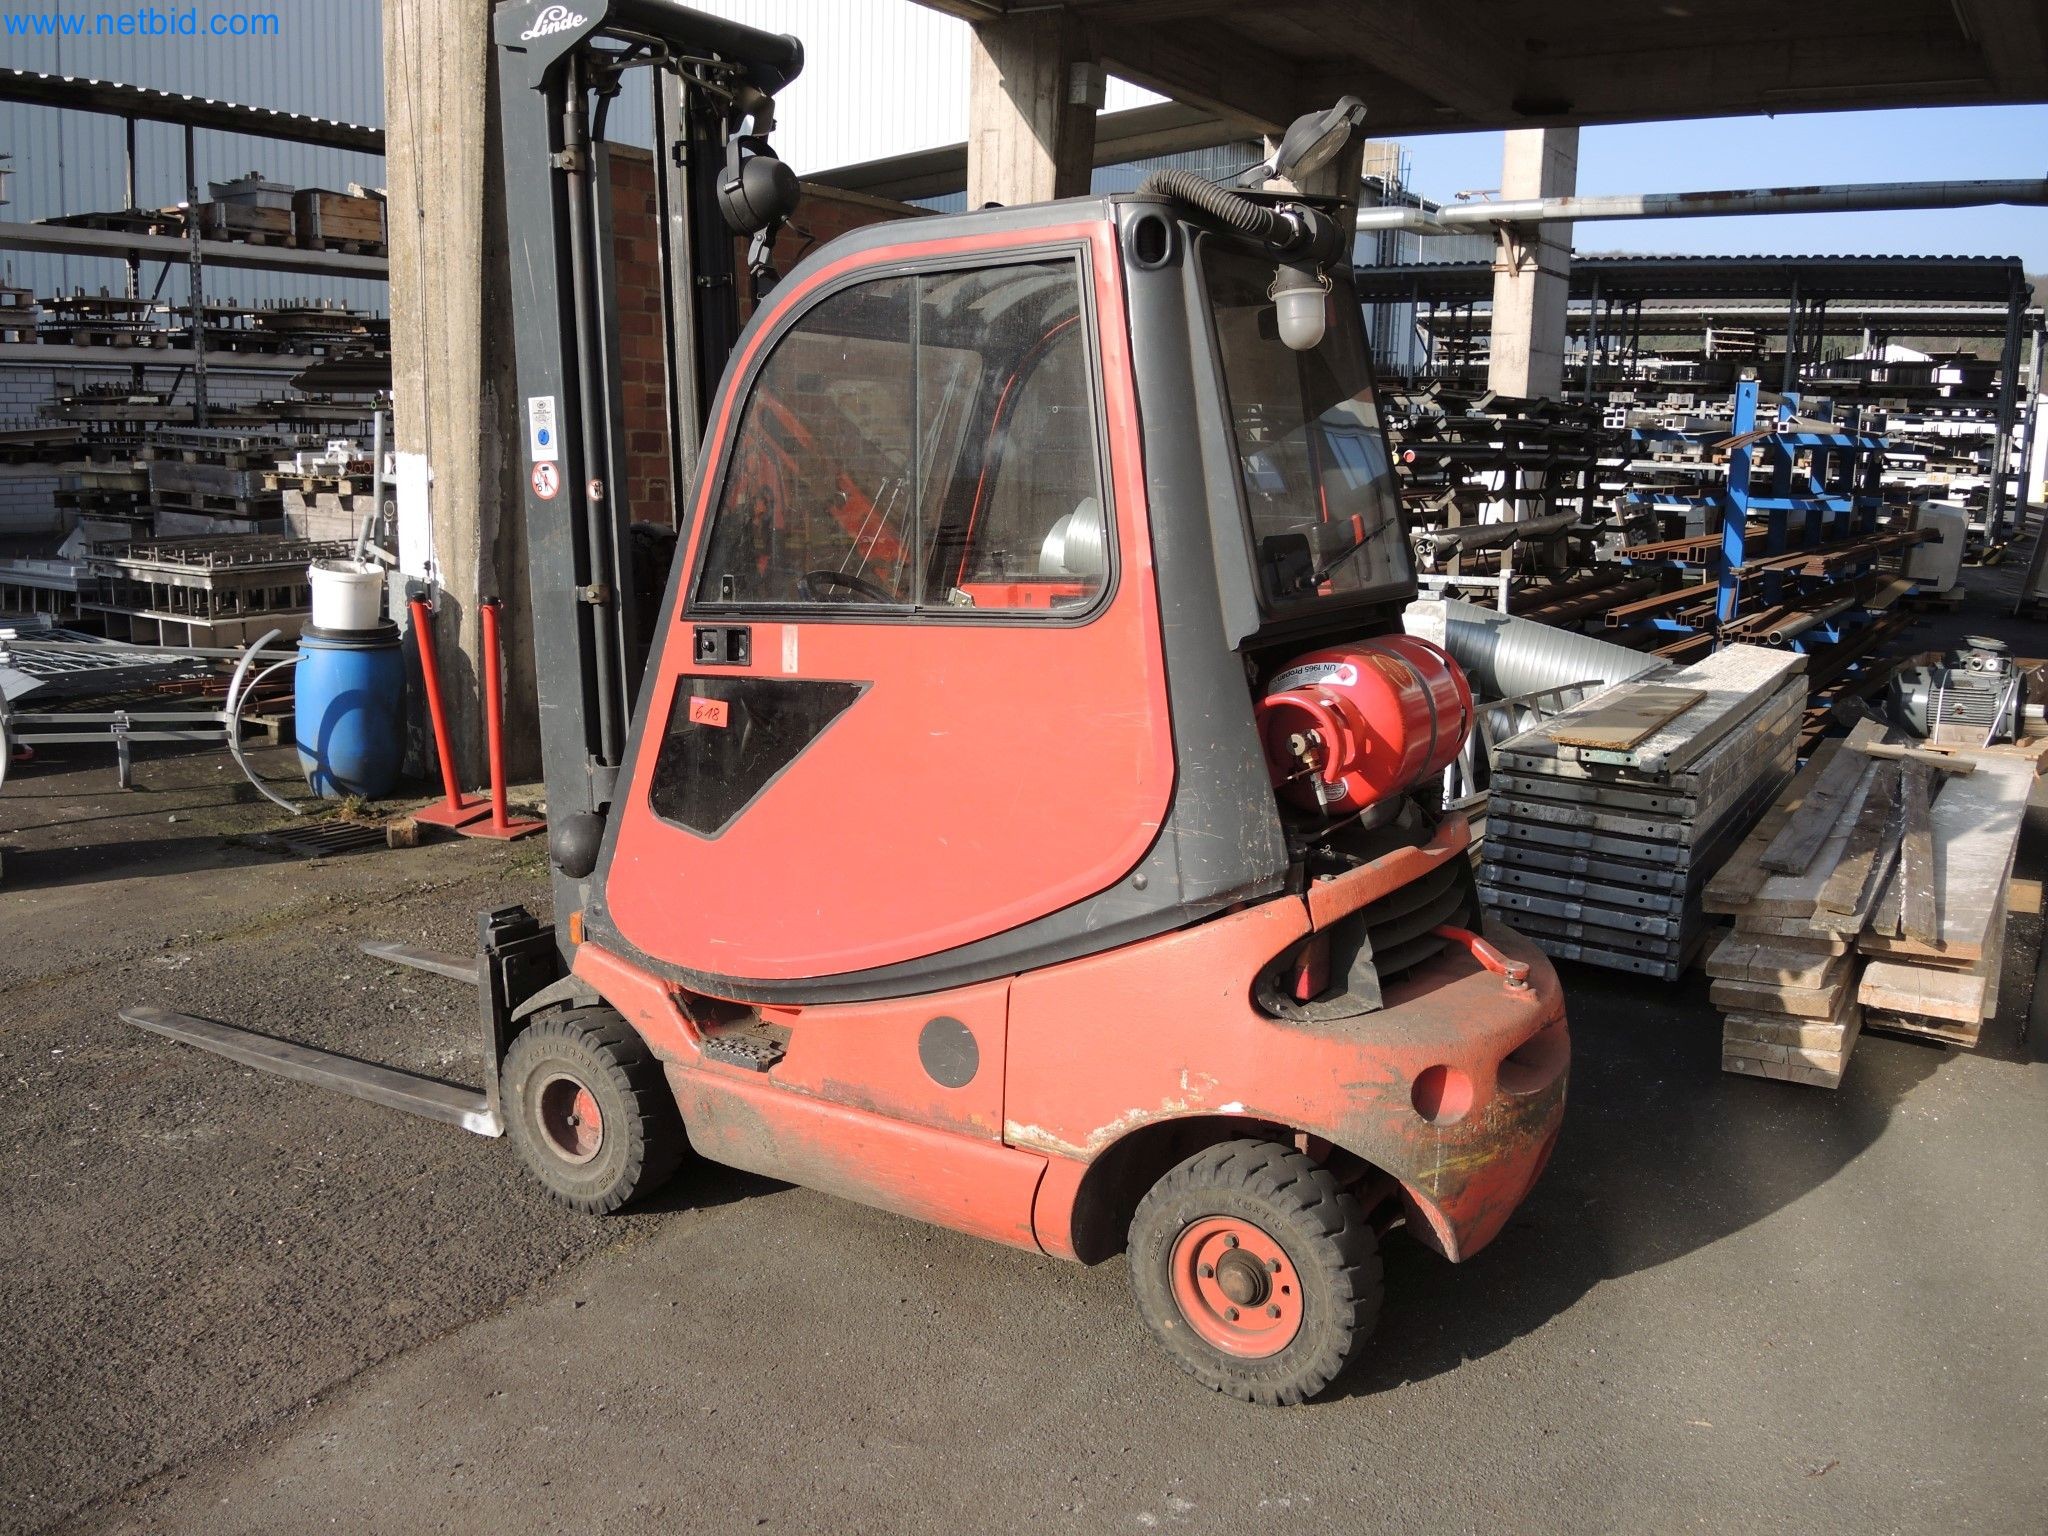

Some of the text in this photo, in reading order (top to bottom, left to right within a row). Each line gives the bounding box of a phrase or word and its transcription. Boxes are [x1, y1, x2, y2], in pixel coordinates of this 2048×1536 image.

[521, 5, 588, 40] Linde
[1277, 668, 1303, 682] Propan
[1305, 665, 1321, 673] 1965
